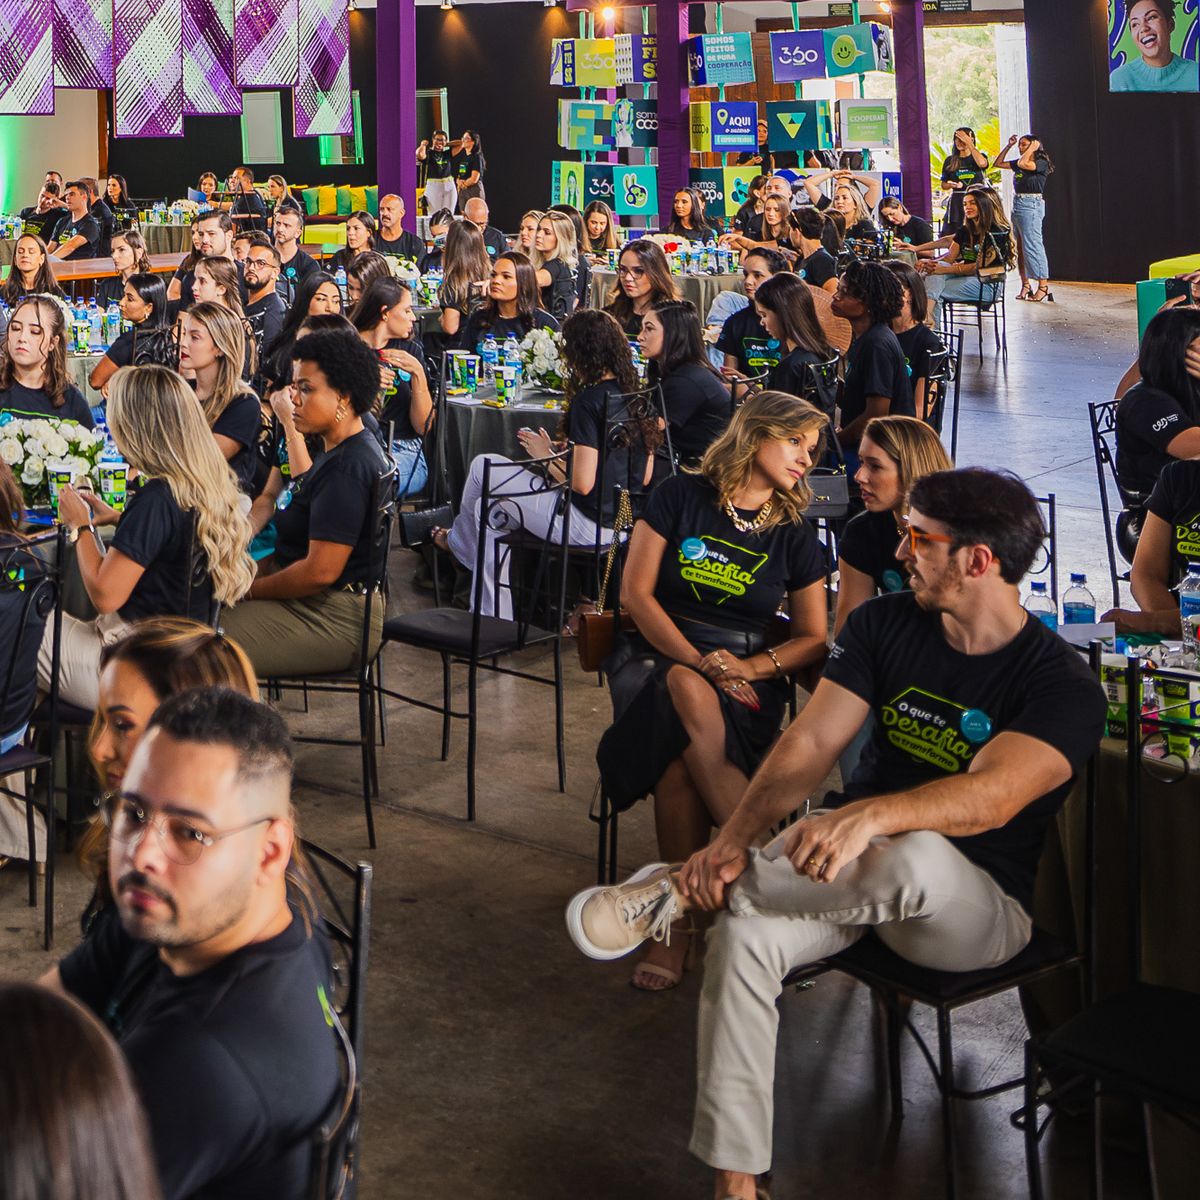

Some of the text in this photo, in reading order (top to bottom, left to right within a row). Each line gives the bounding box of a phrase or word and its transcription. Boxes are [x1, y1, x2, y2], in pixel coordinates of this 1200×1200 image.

[705, 36, 735, 45] SOMOS
[705, 45, 736, 54] FEITOS
[779, 46, 819, 66] 360
[636, 111, 657, 119] som
[729, 116, 751, 127] AQUI
[707, 550, 730, 564] ue te
[695, 572, 741, 592] transforma
[909, 707, 932, 721] que
[933, 714, 947, 727] te
[881, 705, 974, 760] Desafia
[902, 738, 955, 768] transforma
